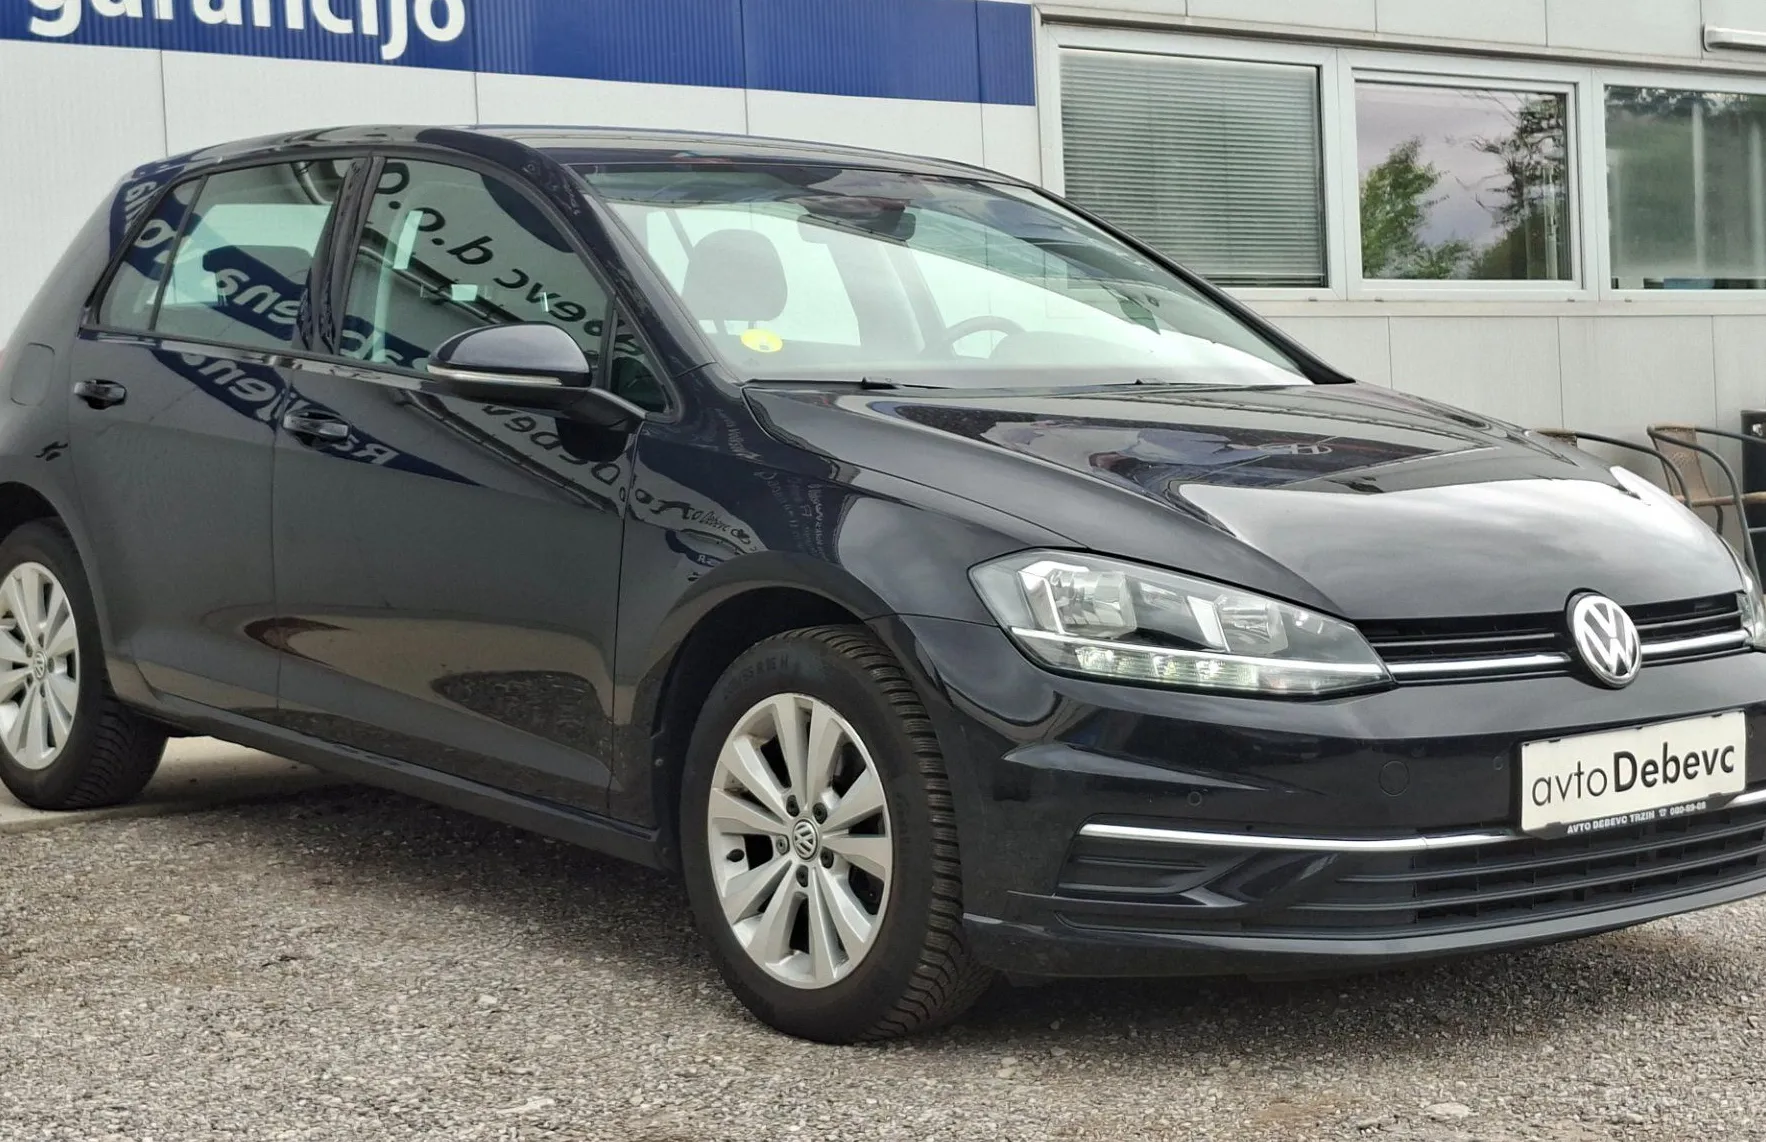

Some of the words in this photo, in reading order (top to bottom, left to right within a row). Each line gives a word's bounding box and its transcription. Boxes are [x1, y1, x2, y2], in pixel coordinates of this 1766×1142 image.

[1567, 820, 1591, 835] AVTO
[1593, 815, 1628, 830] DEBEVC
[1630, 810, 1655, 823] TRZIN
